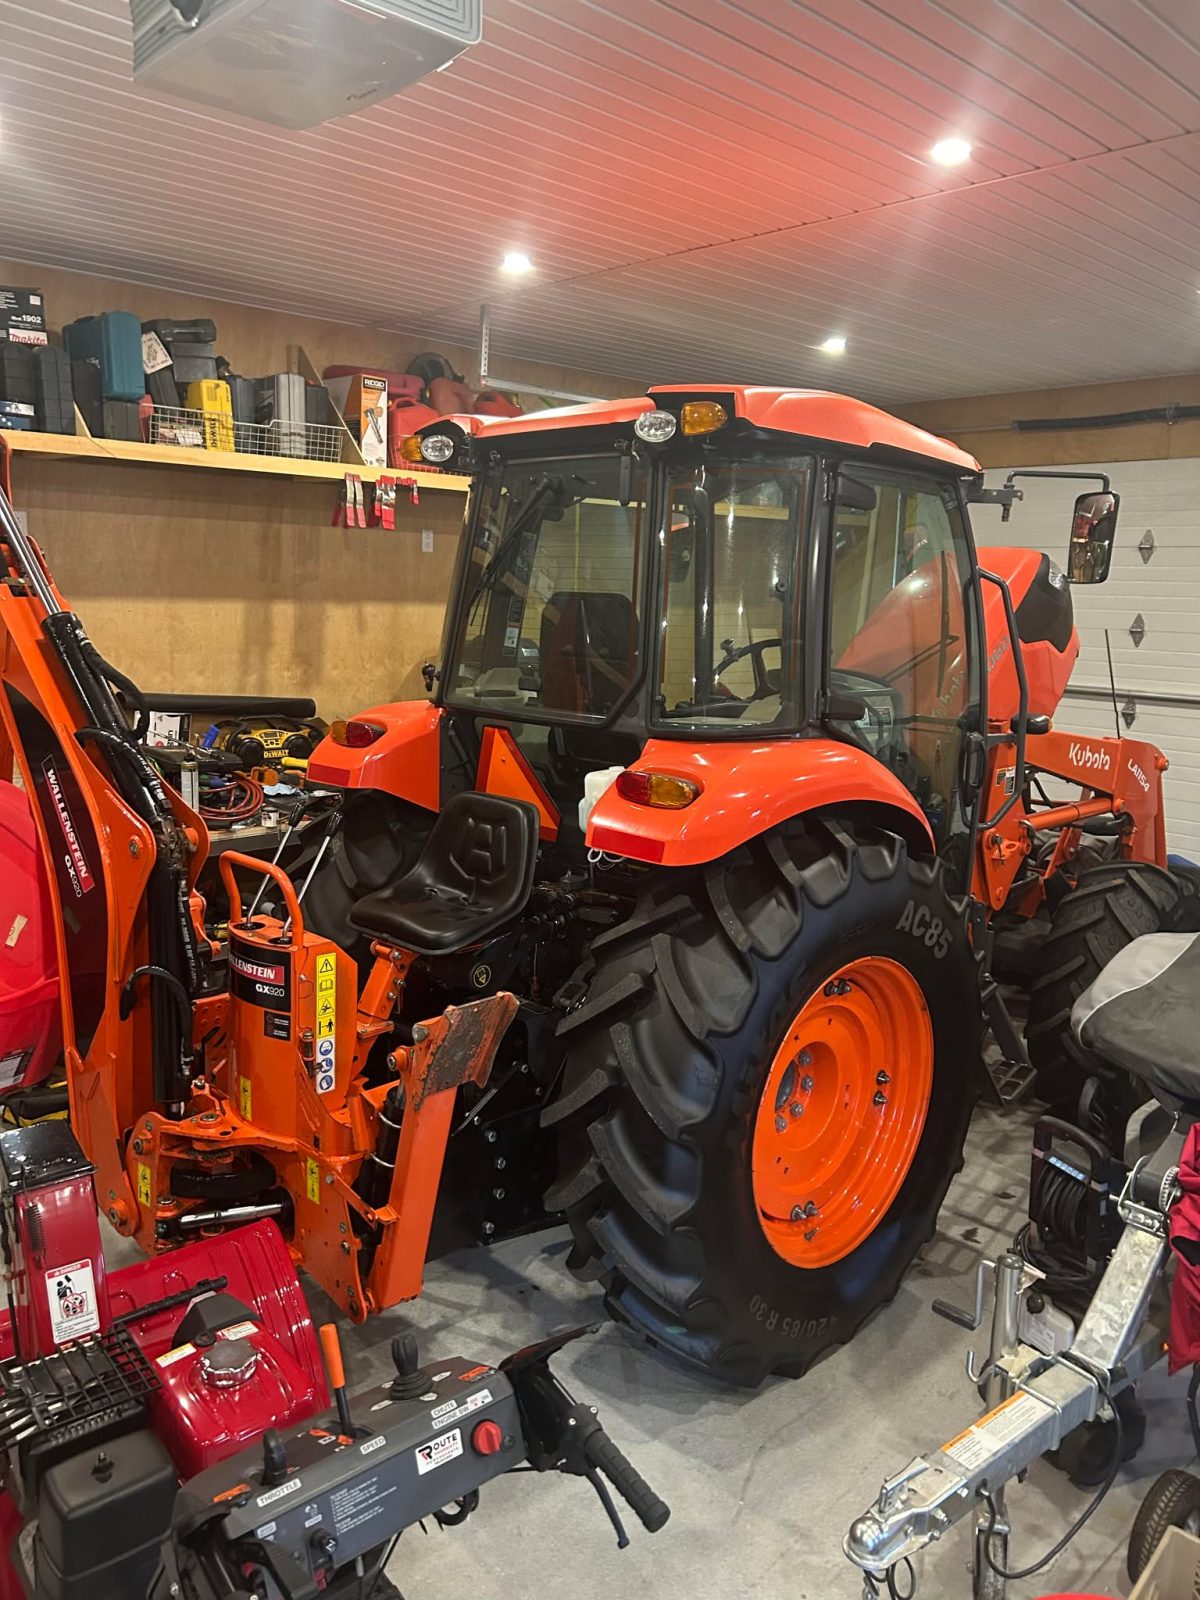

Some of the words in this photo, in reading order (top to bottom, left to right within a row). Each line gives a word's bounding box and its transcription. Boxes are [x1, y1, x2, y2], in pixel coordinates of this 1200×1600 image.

[11, 333, 46, 345] makita
[1069, 742, 1110, 771] Kubota
[1127, 758, 1151, 792] LA1154
[47, 768, 88, 878] WALLENSTEIN
[64, 854, 82, 898] GX920
[894, 899, 954, 959] AC85
[255, 983, 285, 997] GX920
[749, 1294, 768, 1321] 30
[765, 1309, 779, 1330] R
[781, 1315, 838, 1338] 420/85
[433, 1402, 455, 1416] CHUTE
[434, 1412, 459, 1427] ENGINE
[458, 1405, 470, 1415] SW
[362, 1439, 385, 1453] SPEED
[418, 1433, 458, 1460] ROUTE
[260, 1481, 299, 1505] THROTTLE
